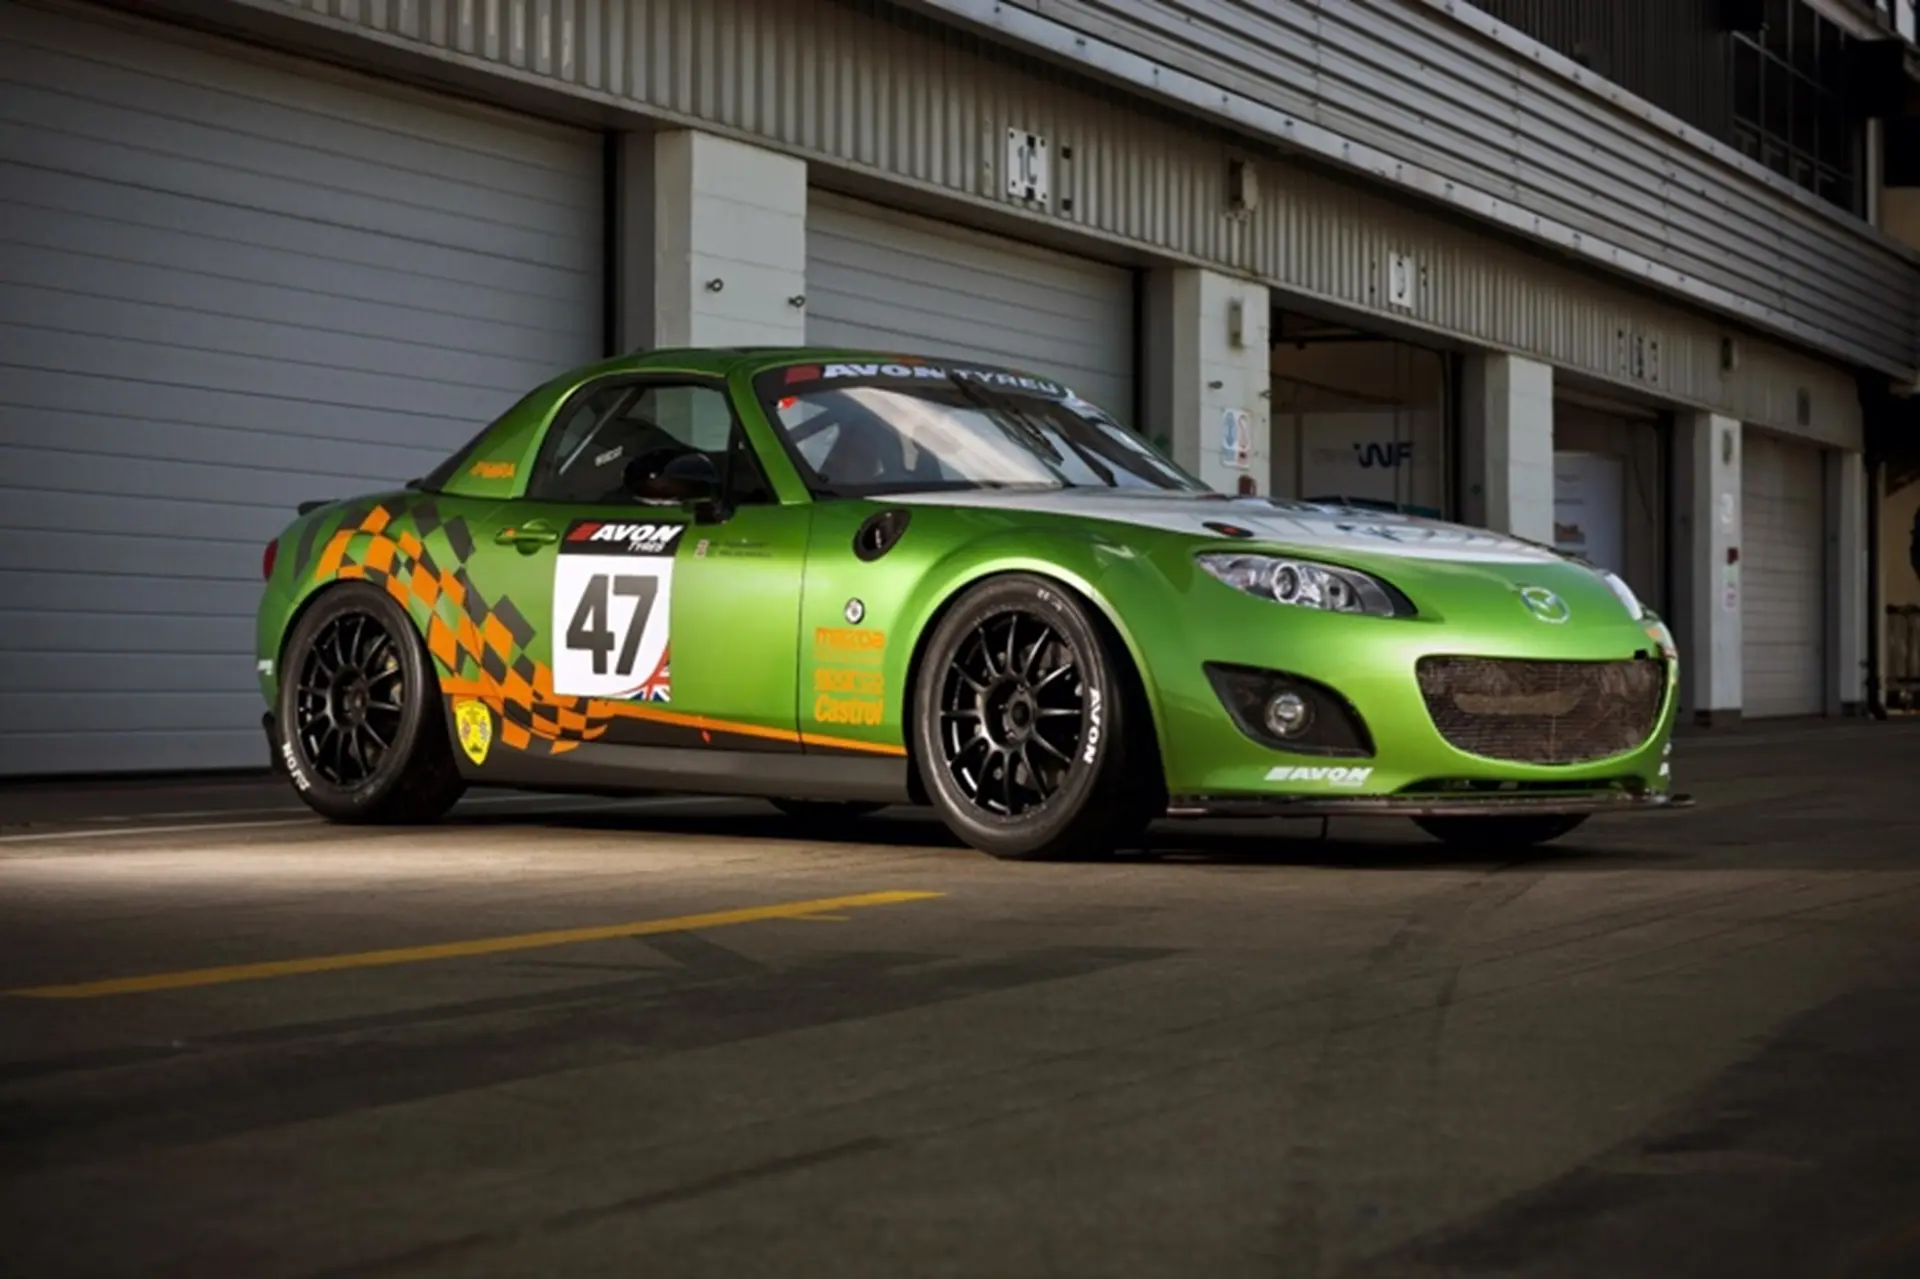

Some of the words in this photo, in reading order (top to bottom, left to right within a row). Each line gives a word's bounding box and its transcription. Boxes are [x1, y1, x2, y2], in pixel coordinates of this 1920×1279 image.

[823, 363, 946, 380] AVON
[590, 524, 684, 543] AVON
[566, 573, 659, 677] 47
[814, 695, 884, 726] Castrol
[1083, 686, 1101, 764] AVON
[1288, 766, 1375, 782] AVON
